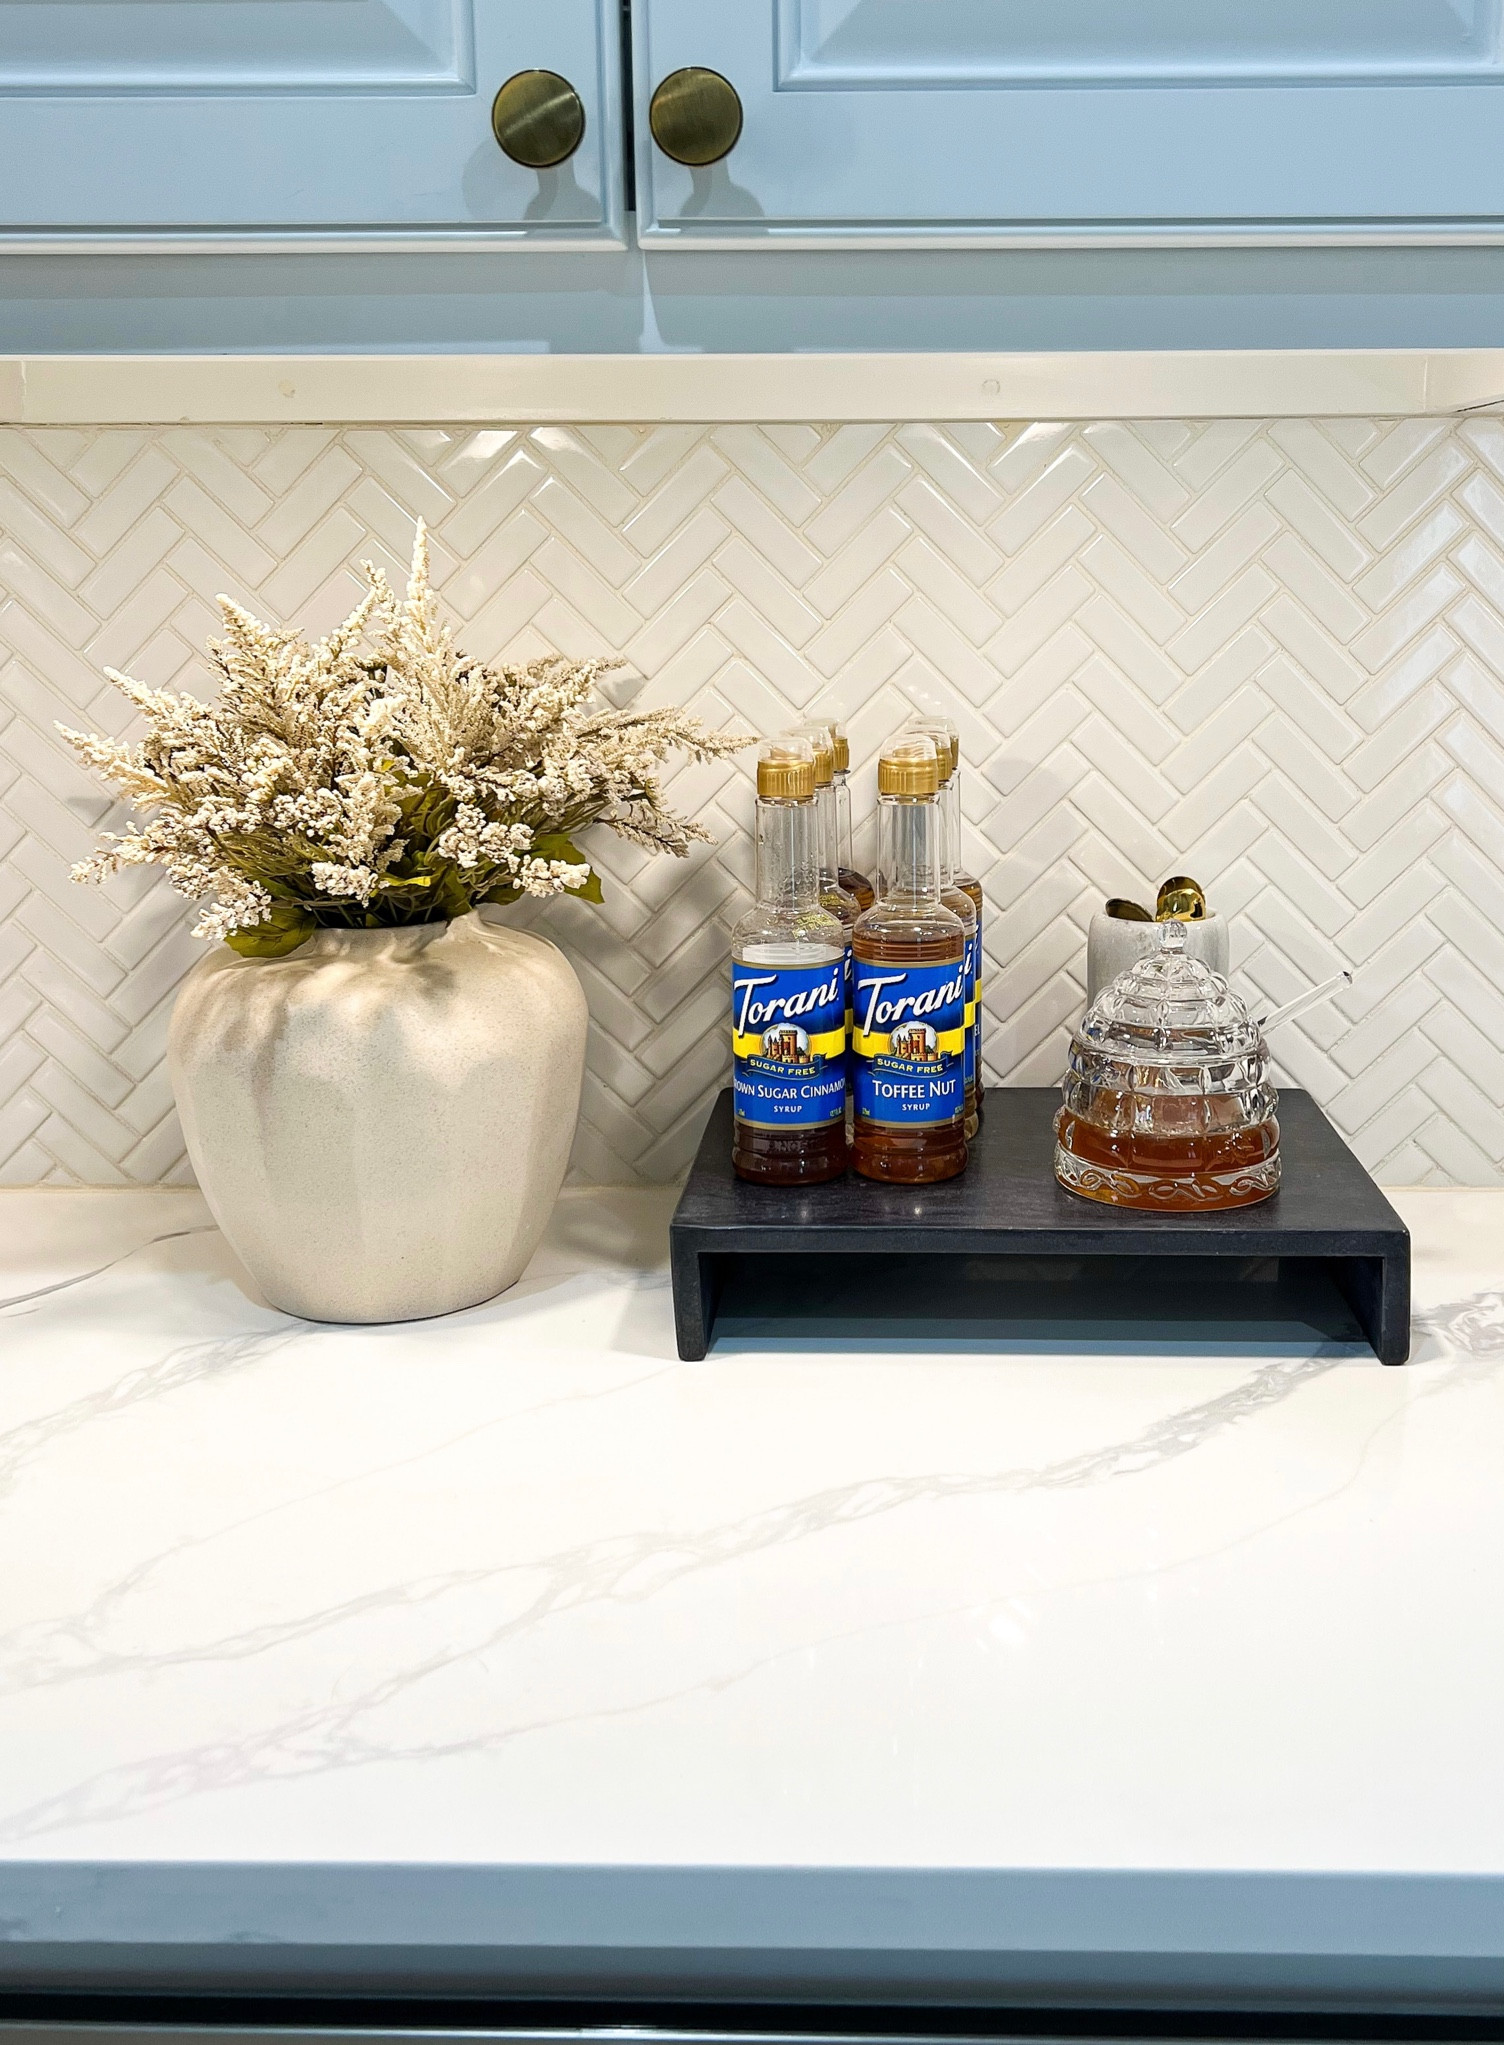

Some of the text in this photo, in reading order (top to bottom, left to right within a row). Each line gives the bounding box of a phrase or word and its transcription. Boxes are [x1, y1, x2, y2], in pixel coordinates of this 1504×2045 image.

[734, 967, 839, 1036] Torani
[858, 965, 963, 1037] Torani
[750, 1059, 816, 1076] SUGAR FREE
[877, 1058, 943, 1074] SUGAR FREE
[757, 1084, 798, 1099] SUGAR
[872, 1079, 925, 1099] TOFFEE
[930, 1079, 956, 1098] NUT
[773, 1105, 803, 1113] SYRUP
[901, 1103, 931, 1111] SYRUP
